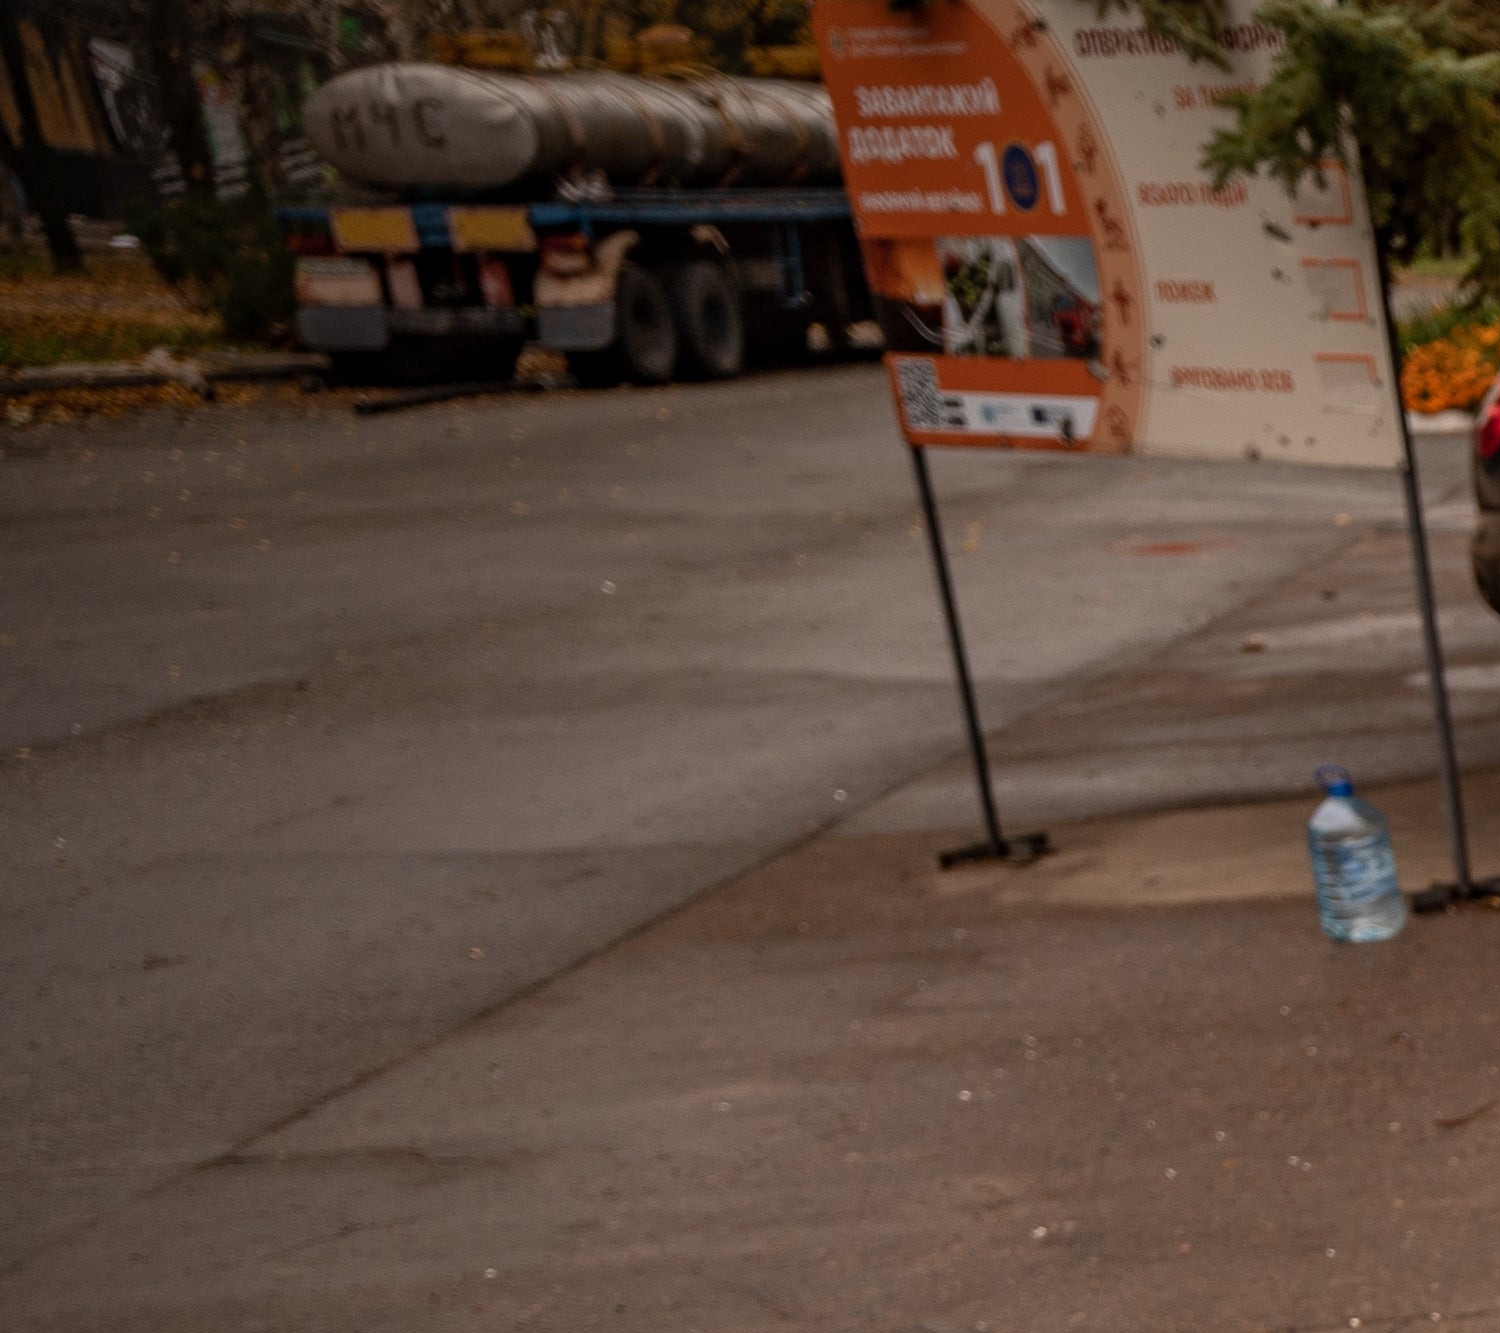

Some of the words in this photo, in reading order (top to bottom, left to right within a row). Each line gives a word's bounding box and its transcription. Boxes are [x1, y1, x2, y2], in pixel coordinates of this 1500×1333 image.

[854, 76, 1000, 118] ЗАВАНТАЖУЙ
[331, 98, 447, 150] МЧС
[848, 126, 957, 165] ДОДАТОК
